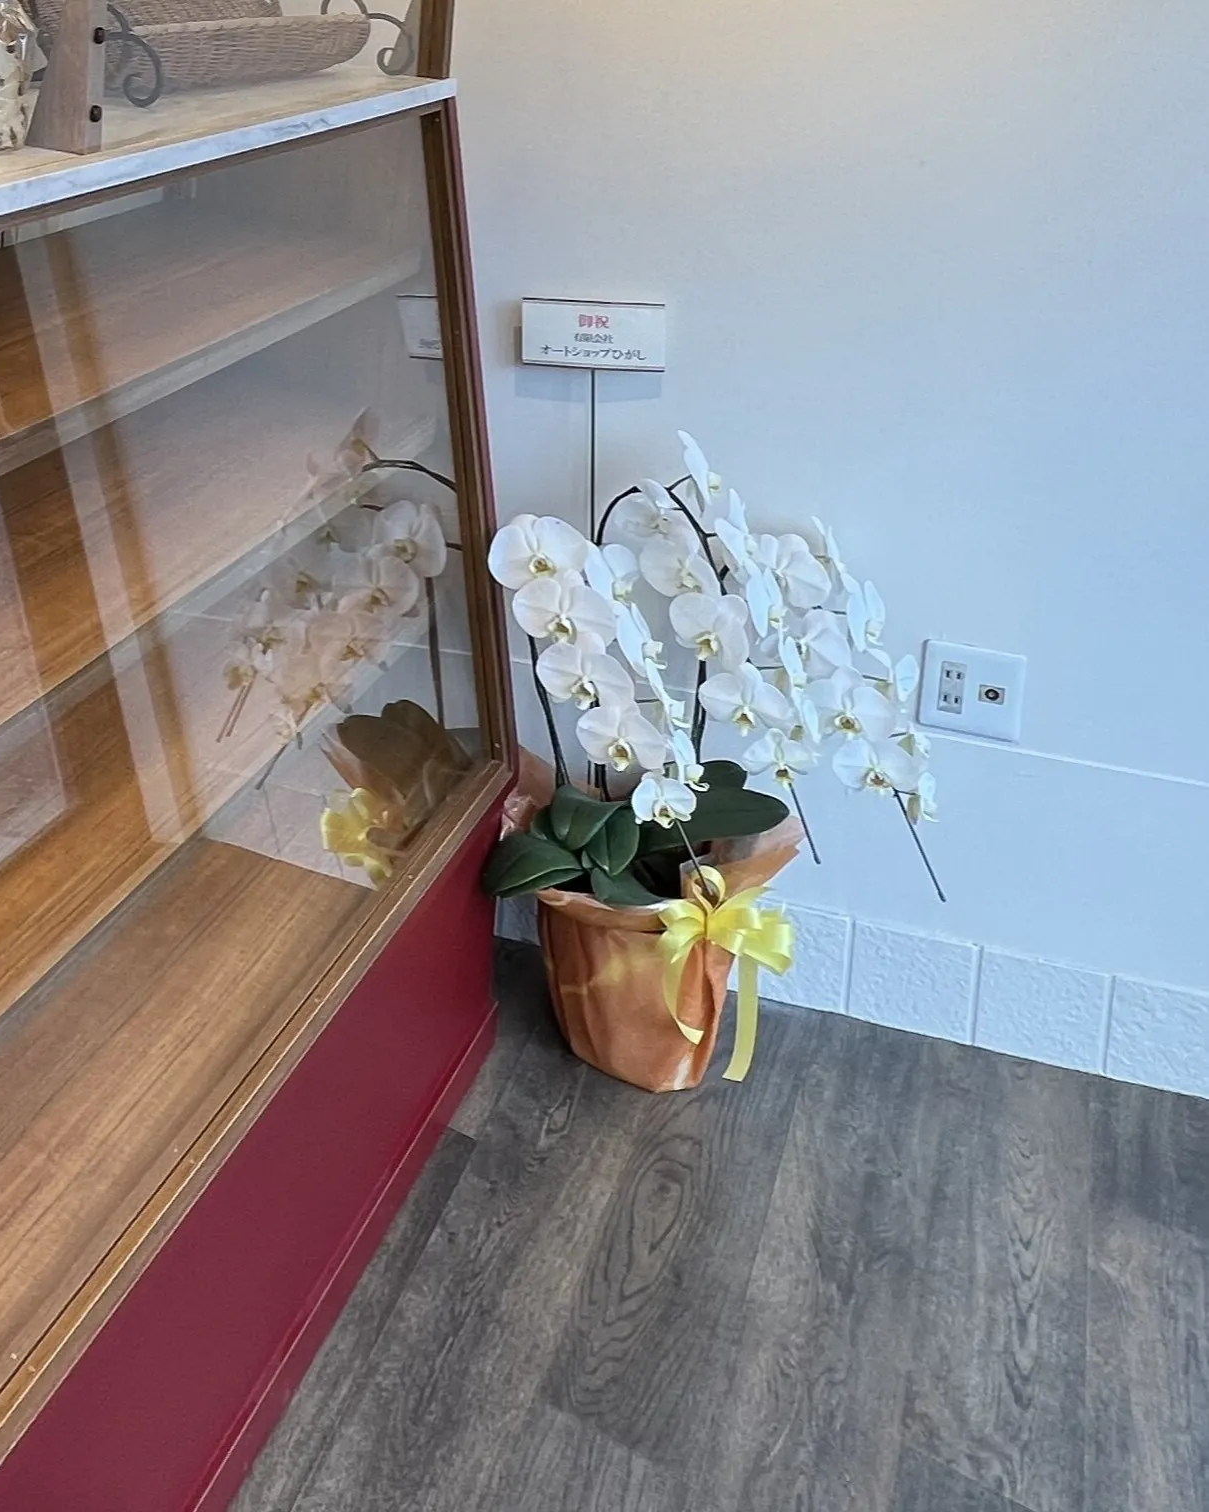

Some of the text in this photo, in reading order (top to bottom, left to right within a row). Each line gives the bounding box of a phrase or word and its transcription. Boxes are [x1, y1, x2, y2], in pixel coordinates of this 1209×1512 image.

[577, 314, 611, 329] 御祝
[573, 332, 615, 345] 有限会社
[539, 344, 647, 361] オートショップひがし
